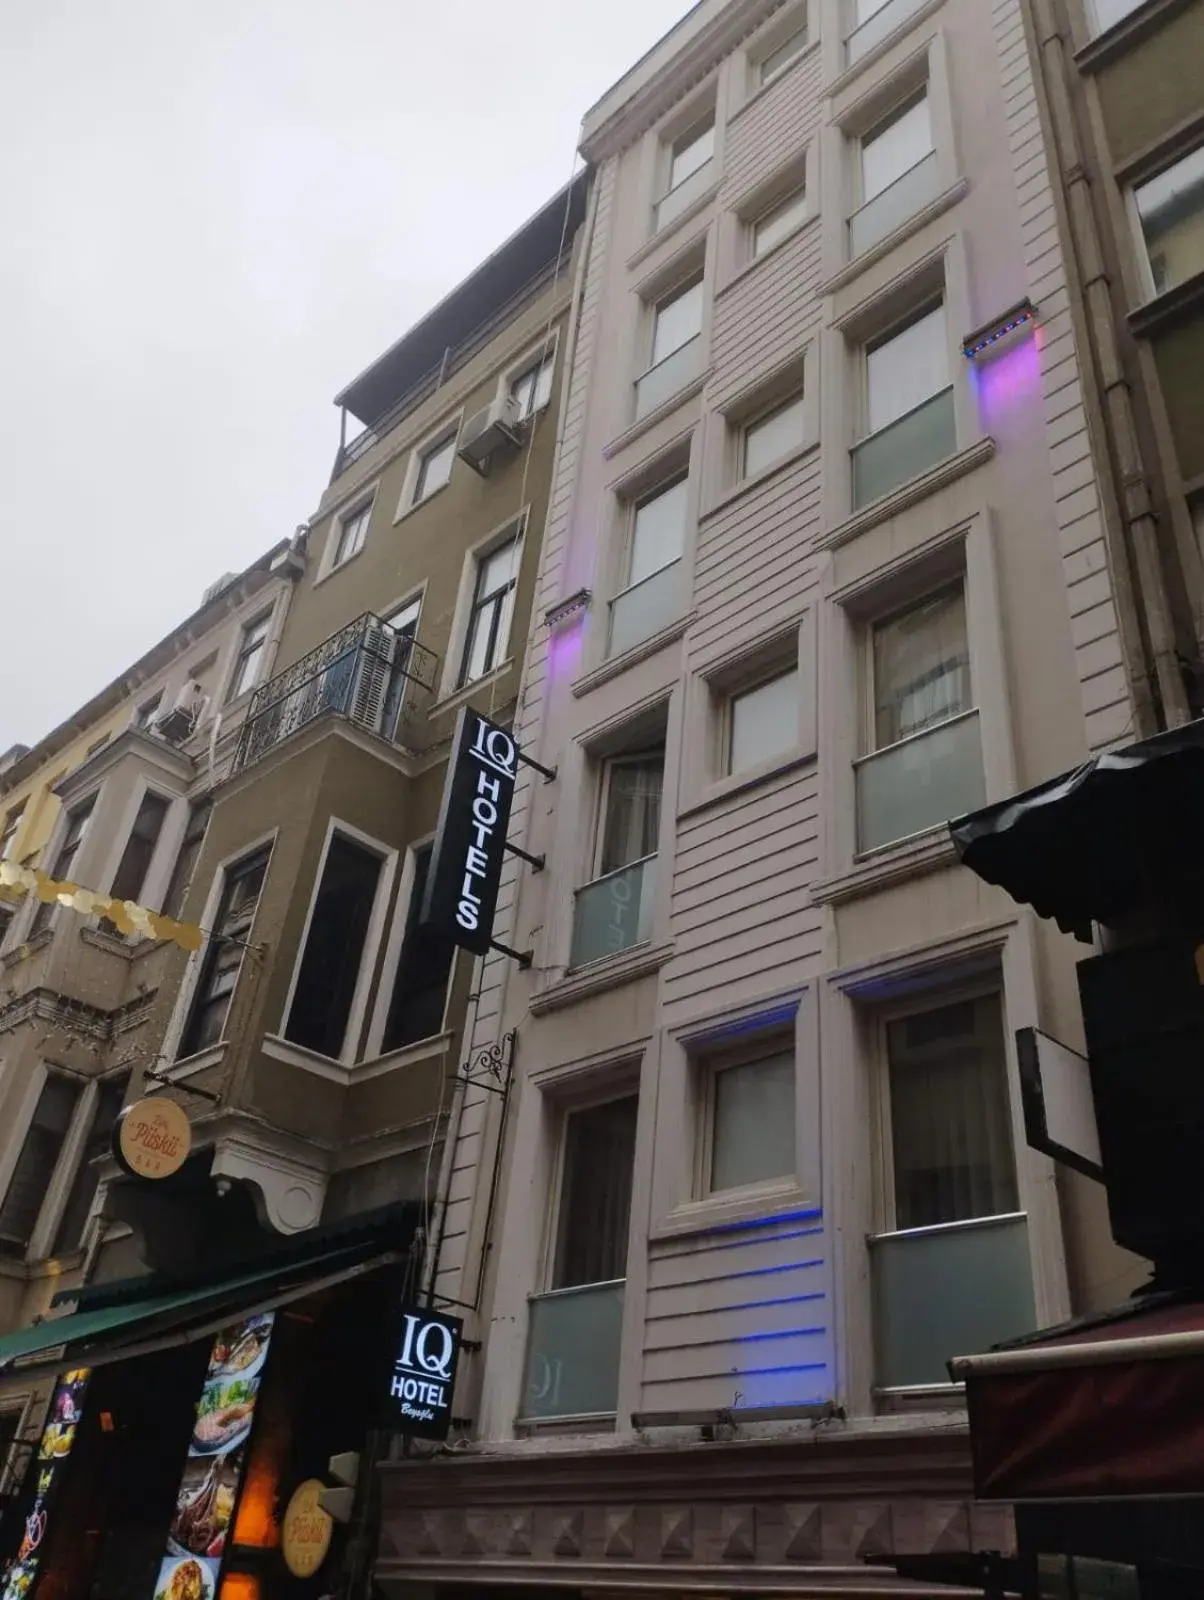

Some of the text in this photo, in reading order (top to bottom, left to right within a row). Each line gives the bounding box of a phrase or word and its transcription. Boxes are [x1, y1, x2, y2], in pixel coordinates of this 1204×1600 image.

[472, 718, 516, 773] IQ
[456, 771, 500, 930] HOTELS
[396, 1314, 453, 1378] IQ
[390, 1375, 448, 1408] HOTEL
